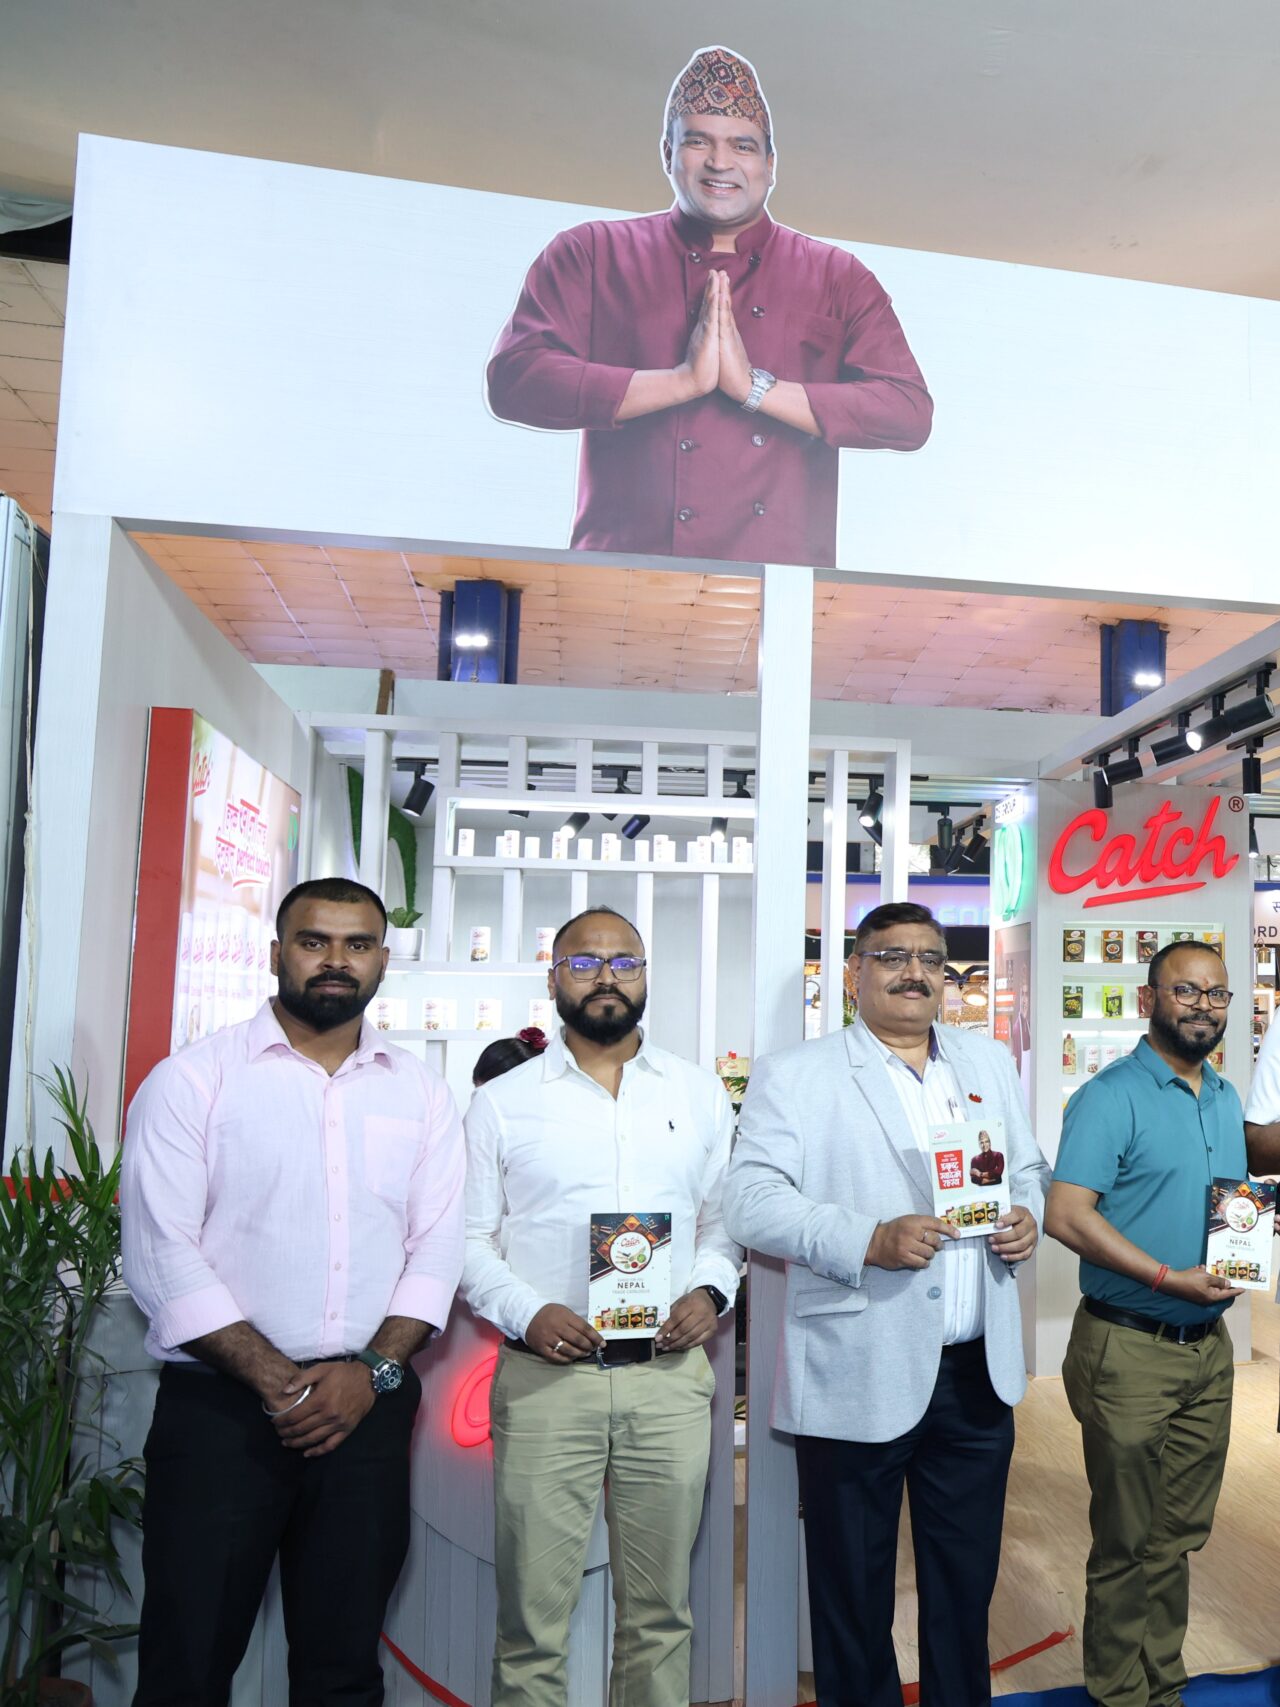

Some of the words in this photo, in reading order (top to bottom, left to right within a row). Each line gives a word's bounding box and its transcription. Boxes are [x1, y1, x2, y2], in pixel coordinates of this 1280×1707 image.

[1048, 796, 1240, 908] Catch
[1254, 926, 1278, 938] RD
[1230, 1239, 1251, 1247] NEPAL
